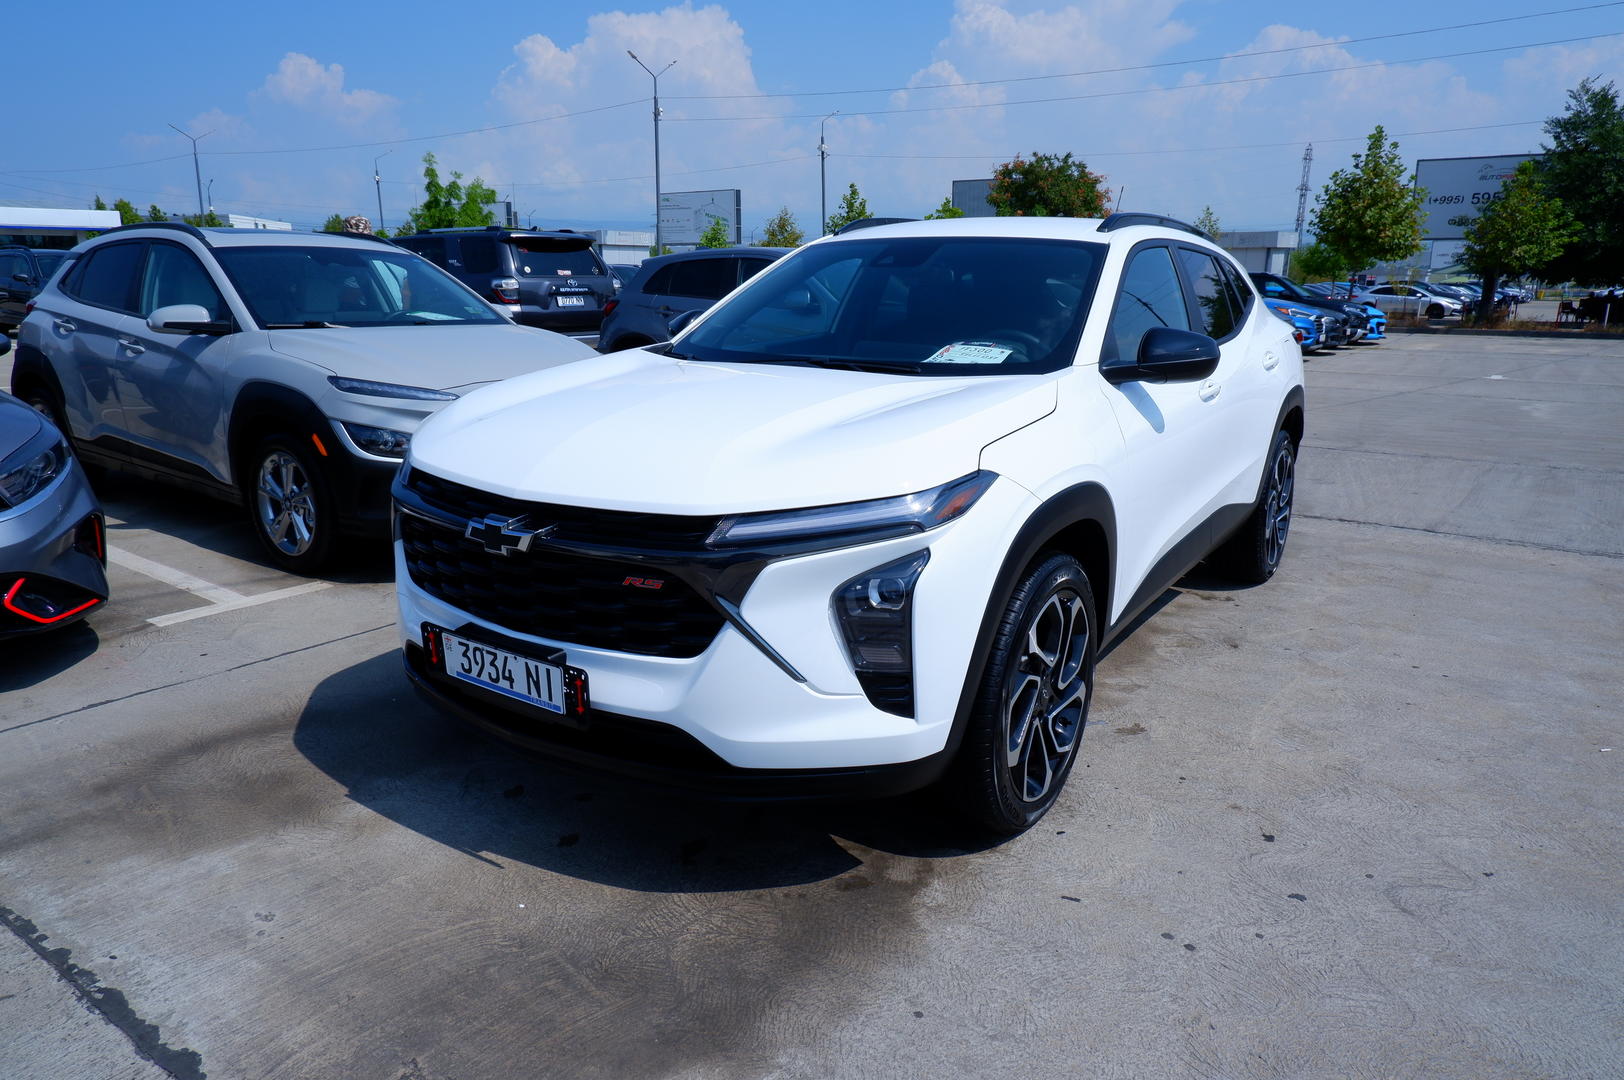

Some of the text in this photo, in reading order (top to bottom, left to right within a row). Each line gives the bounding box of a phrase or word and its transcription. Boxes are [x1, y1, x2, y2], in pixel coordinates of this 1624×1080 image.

[1429, 195, 1464, 205] (+995)
[623, 576, 664, 589] RS
[457, 641, 553, 702] 3934 NI
